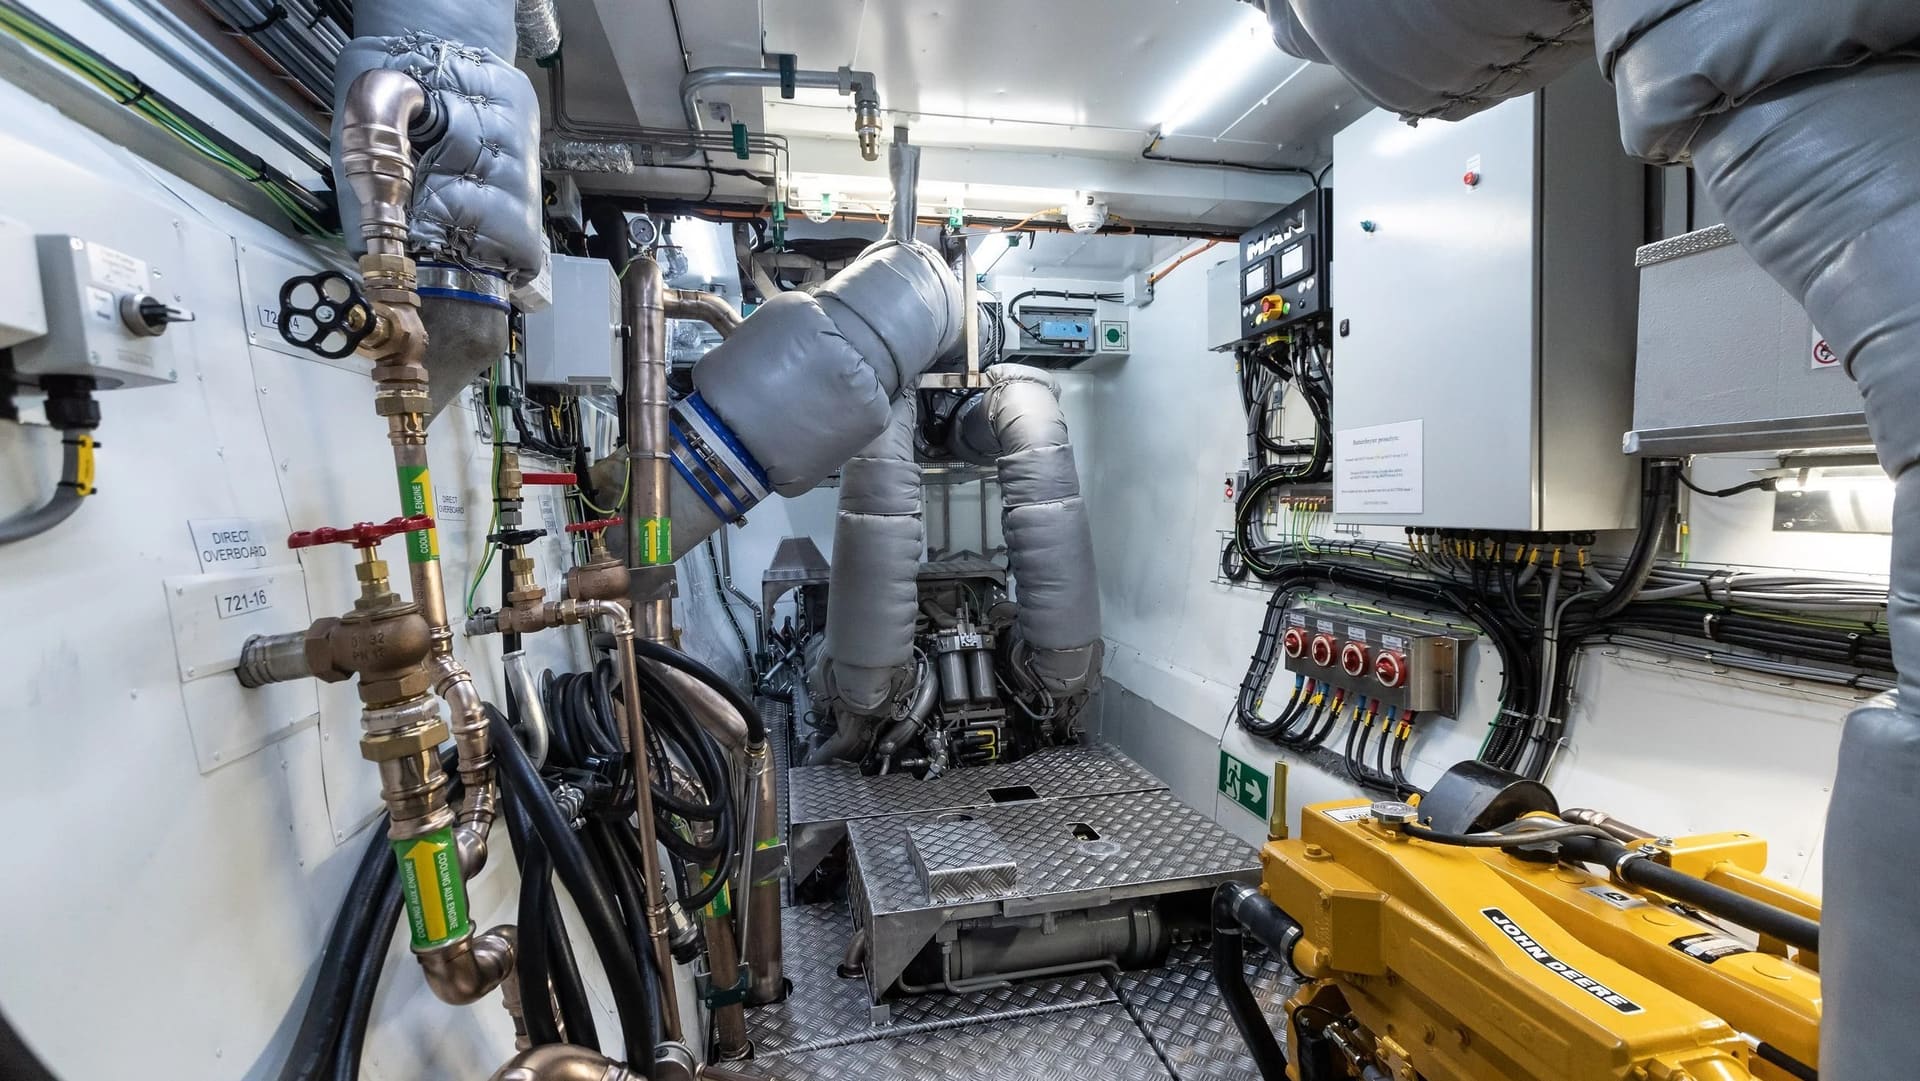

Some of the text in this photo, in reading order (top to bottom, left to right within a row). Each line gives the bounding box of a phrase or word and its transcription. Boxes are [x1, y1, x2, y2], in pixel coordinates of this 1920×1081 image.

[1246, 209, 1305, 262] MAN
[203, 545, 267, 562] OVERBOARD
[212, 530, 249, 544] DIRECT
[224, 589, 267, 613] 721-16
[438, 853, 451, 887] COOLING
[412, 905, 426, 938] COOLING
[1491, 916, 1628, 1006] JOHN DEERE
